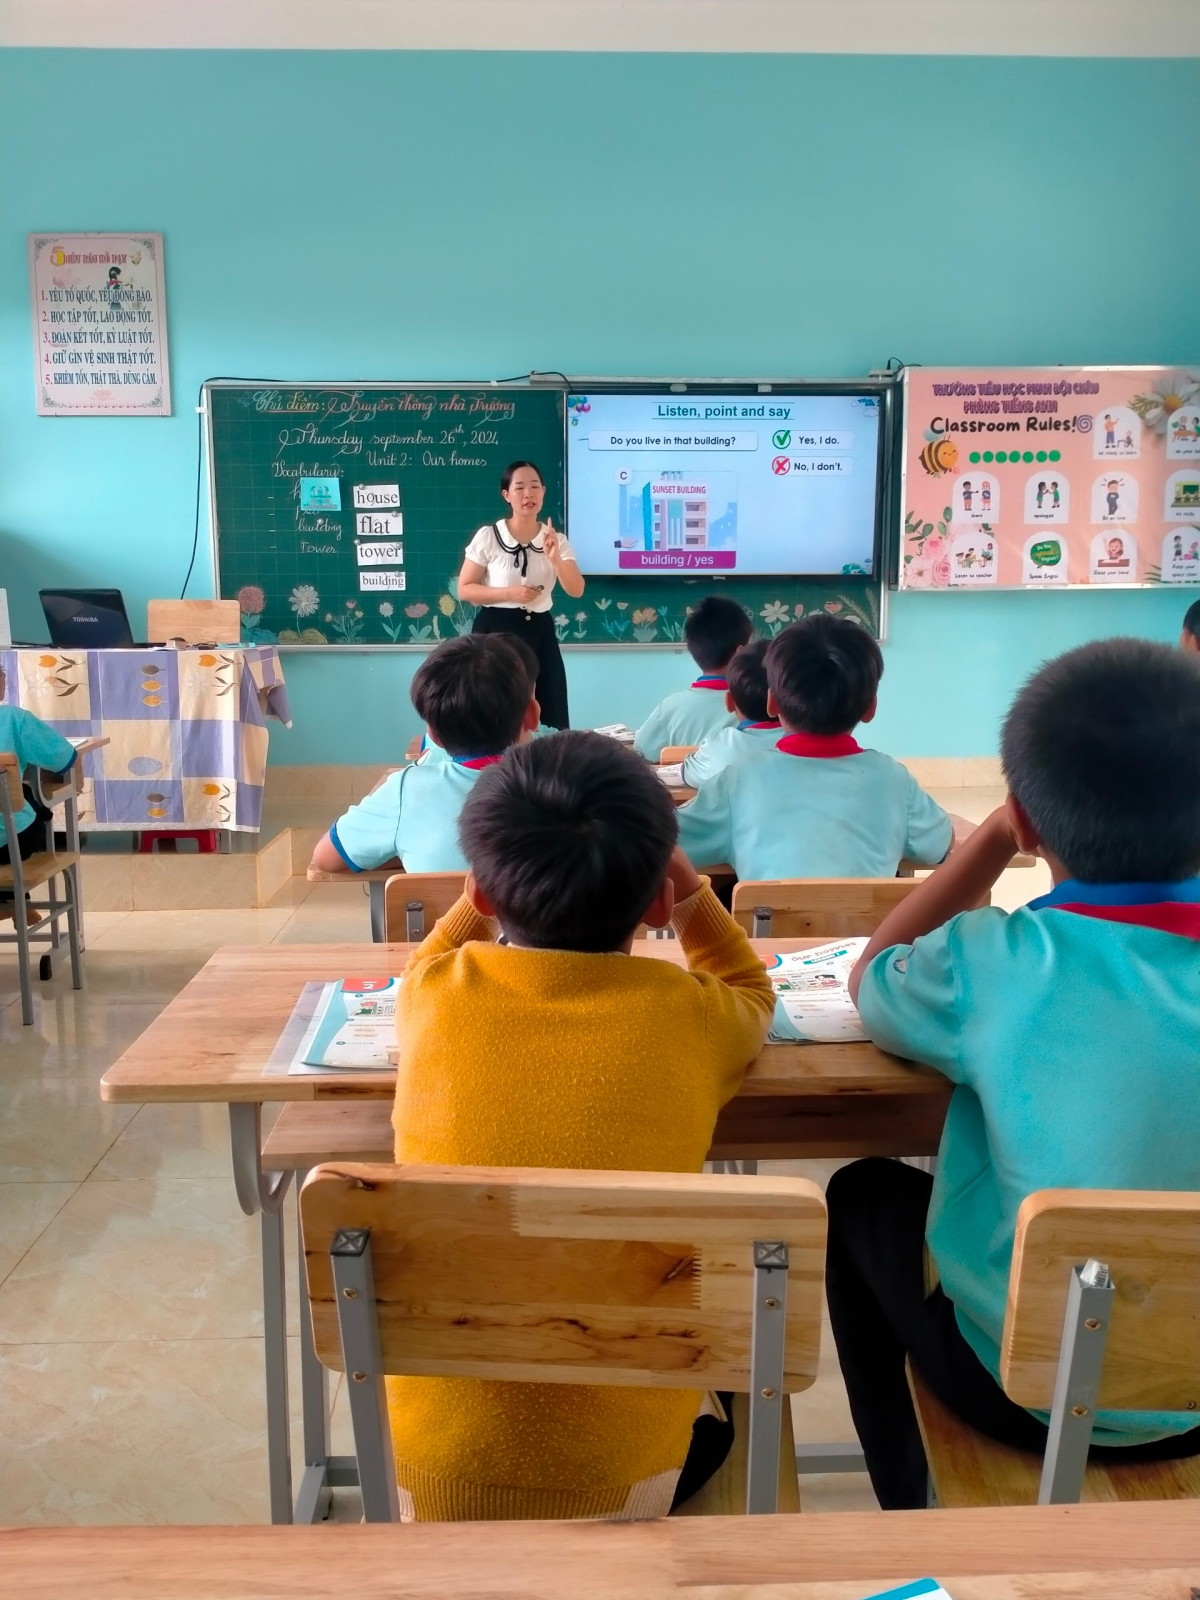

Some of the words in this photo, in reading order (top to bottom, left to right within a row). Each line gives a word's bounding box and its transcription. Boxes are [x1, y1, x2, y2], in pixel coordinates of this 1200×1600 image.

[41, 290, 48, 301] 1.
[49, 287, 63, 302] YÊU
[76, 285, 98, 304] QUỐC,
[115, 285, 135, 302] ĐỒNG
[136, 286, 153, 302] BÀO.
[42, 310, 49, 322] 2.
[50, 311, 65, 325] HỌC
[66, 308, 82, 325] TẬP
[83, 306, 99, 324] TỐT,
[100, 311, 114, 322] LAO
[116, 308, 136, 326] ĐỘNG
[137, 306, 154, 323] TỐT.
[43, 332, 50, 343] 3.
[52, 330, 73, 344] ĐOÀN
[73, 327, 88, 343] KẾT
[89, 327, 105, 345] TỐT,
[106, 327, 117, 343] KỶ
[118, 328, 138, 346] LUẬT
[139, 327, 155, 343] TỐT.
[44, 354, 52, 364] 4.
[52, 350, 67, 365] GIỮ
[68, 349, 82, 364] GÌN
[84, 349, 95, 367] VỆ
[96, 352, 115, 364] SINH
[117, 349, 138, 367] THẬT
[139, 347, 156, 364] TỐT.
[45, 374, 53, 385] 5.
[54, 369, 74, 385] KHIÊM
[75, 368, 90, 387] TỐN,
[91, 369, 107, 387] THẬT
[107, 370, 123, 387] THÀ,
[123, 369, 141, 385] DŨNG
[142, 368, 158, 385] CẢM.
[1002, 383, 1026, 398] HỌC
[439, 394, 467, 411] nhà
[963, 398, 1000, 414] PHÒNG
[1035, 400, 1058, 413] ANH
[657, 404, 701, 418] Listen,
[704, 404, 738, 419] point
[741, 405, 765, 417] and
[768, 407, 791, 420] say
[930, 417, 1021, 434] Classroom
[1026, 416, 1077, 433] Rules!
[275, 422, 363, 459] Thursday
[470, 430, 499, 446] 2024
[610, 436, 623, 445] Do
[625, 438, 643, 447] you
[645, 436, 661, 445] live
[663, 436, 672, 445] in
[674, 436, 692, 445] that
[694, 436, 736, 448] building?
[798, 436, 817, 446] Yes,
[819, 436, 823, 445] I
[825, 436, 840, 445] do.
[366, 451, 397, 467] Unit
[400, 452, 413, 467] 2:
[422, 451, 447, 467] Our
[449, 451, 488, 467] homes
[793, 462, 809, 472] No,
[811, 462, 815, 471] I
[816, 462, 843, 471] don't.
[619, 471, 628, 481] C
[356, 490, 398, 505] house
[652, 485, 676, 494] SUNSET
[676, 486, 706, 495] BUILDING
[360, 515, 391, 535] flat
[360, 546, 401, 558] tower
[641, 554, 685, 566] building
[686, 554, 692, 566] /
[694, 557, 714, 567] yes
[362, 575, 405, 591] building
[791, 953, 812, 962] Our
[814, 941, 857, 957] homes
